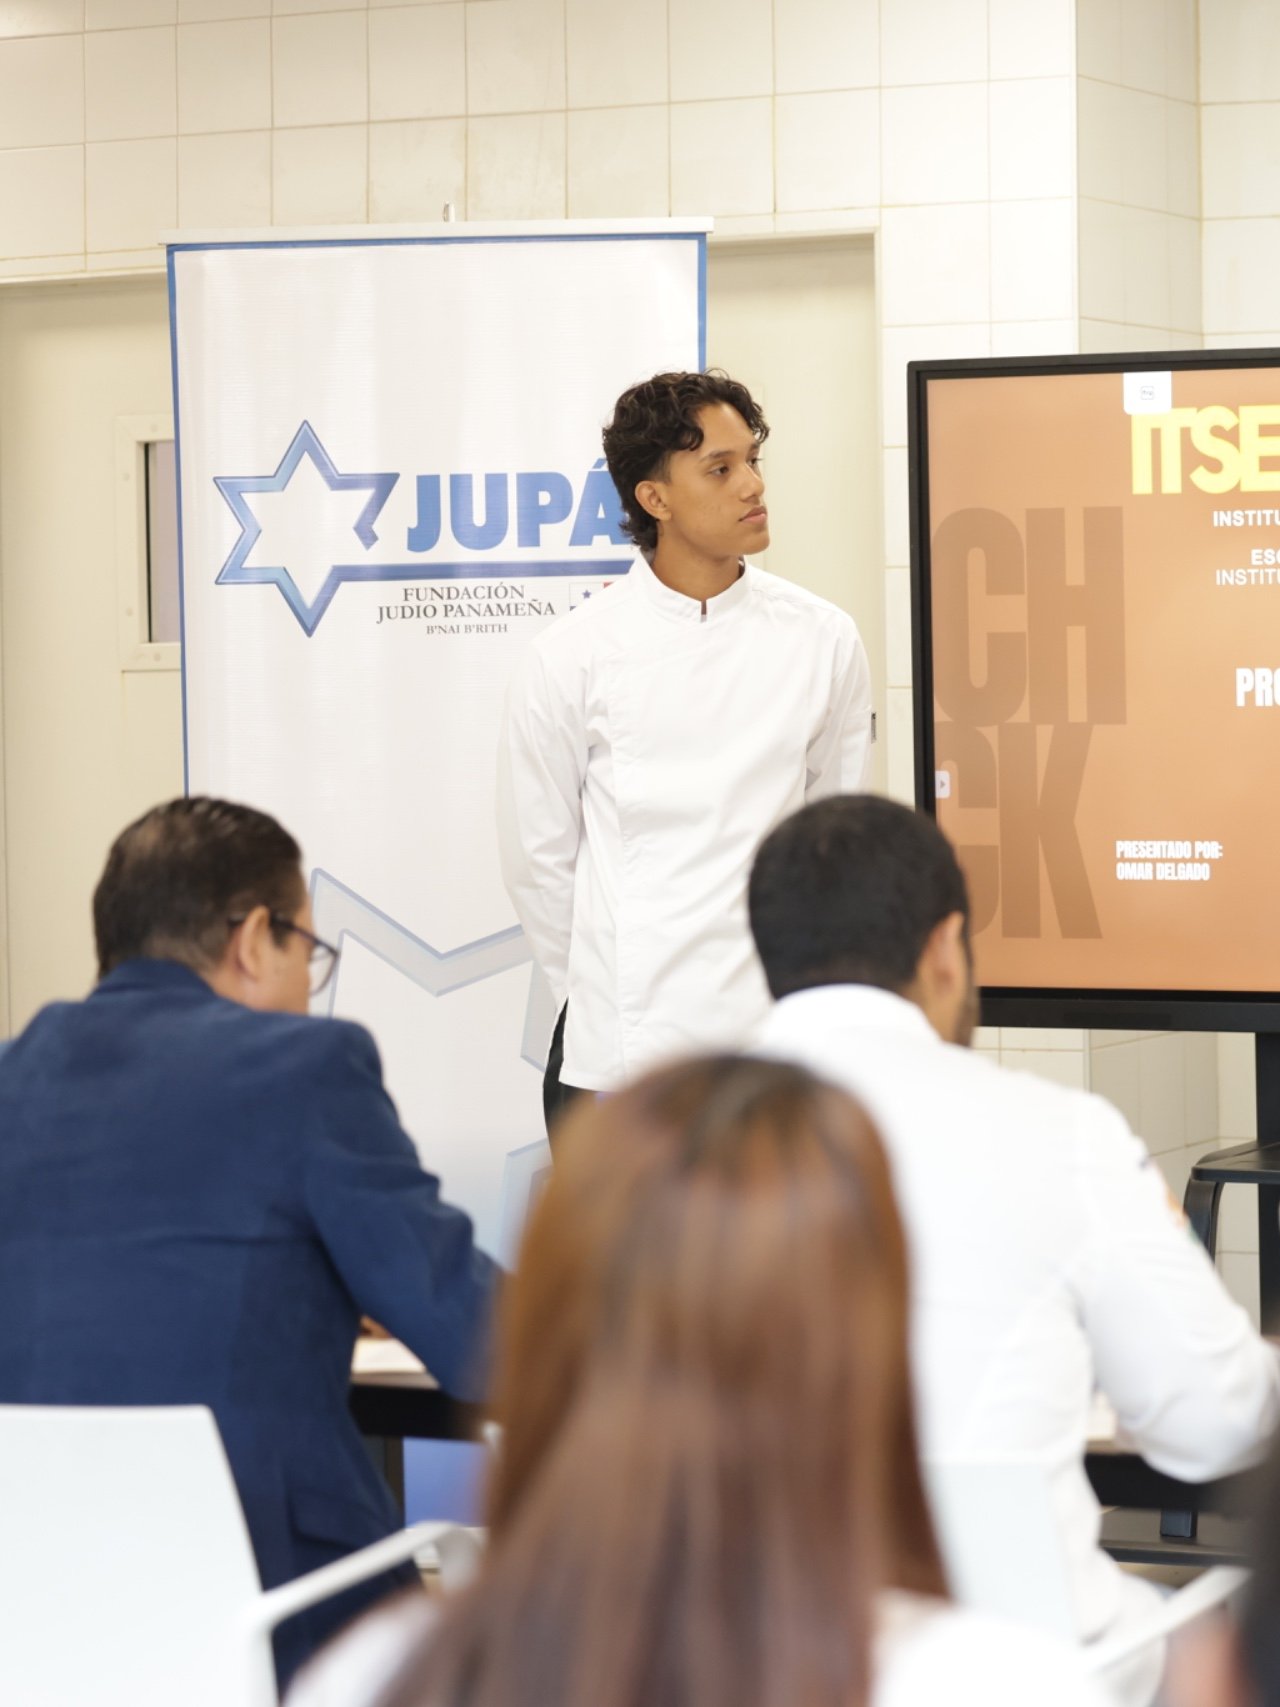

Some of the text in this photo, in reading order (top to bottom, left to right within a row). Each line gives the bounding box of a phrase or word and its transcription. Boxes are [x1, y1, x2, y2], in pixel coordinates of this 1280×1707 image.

[408, 458, 631, 552] JUPÁ
[403, 581, 525, 601] FUNDACIÓN
[376, 599, 556, 624] JUDIO PANAMEÑA
[1115, 841, 1223, 859] PRESENTADO POR:
[1116, 862, 1210, 881] OMAR DELGADO
